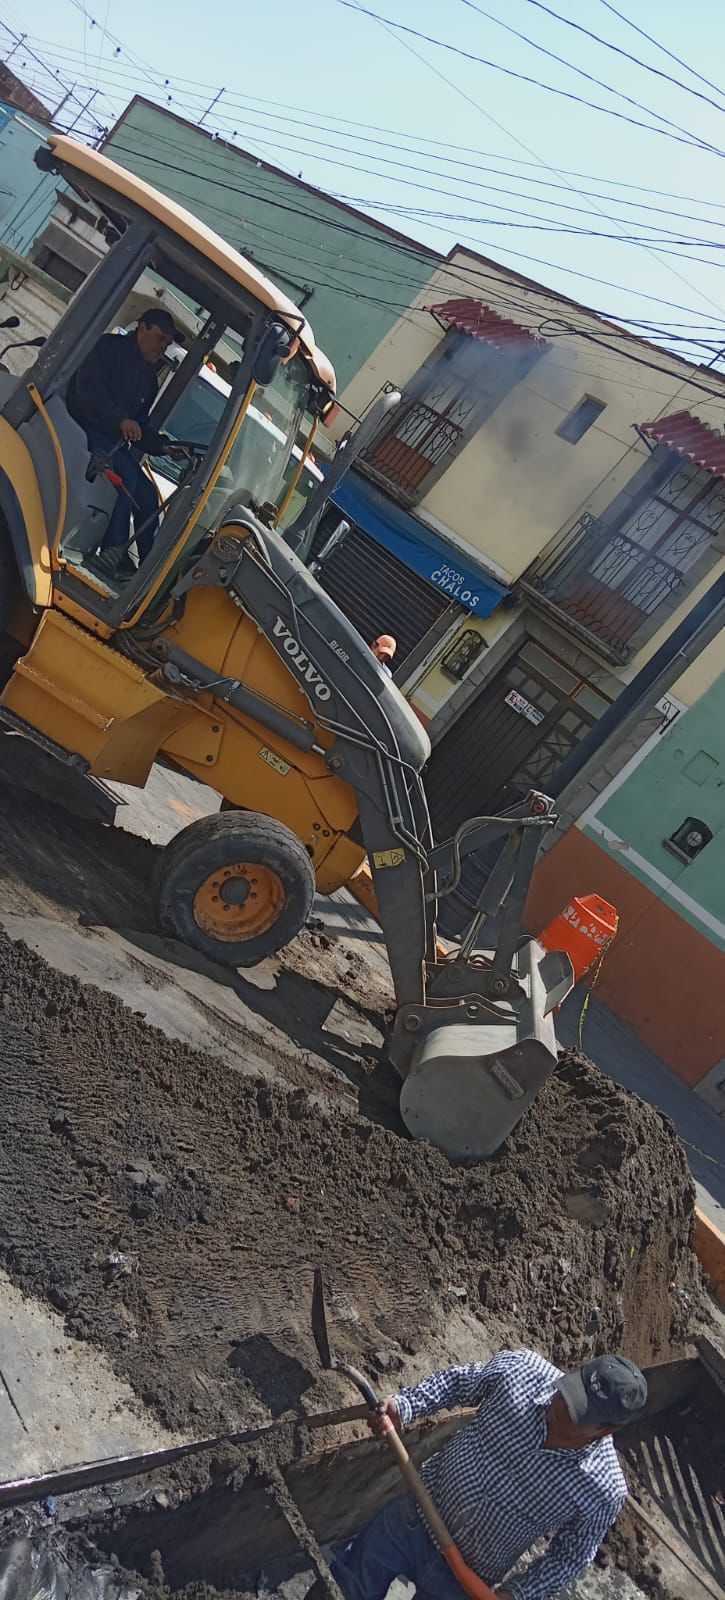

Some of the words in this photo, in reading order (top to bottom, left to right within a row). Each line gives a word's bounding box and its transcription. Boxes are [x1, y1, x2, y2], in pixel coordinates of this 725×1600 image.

[431, 570, 480, 607] CHALOS
[440, 564, 465, 585] TACOS
[272, 615, 331, 701] VOLVO
